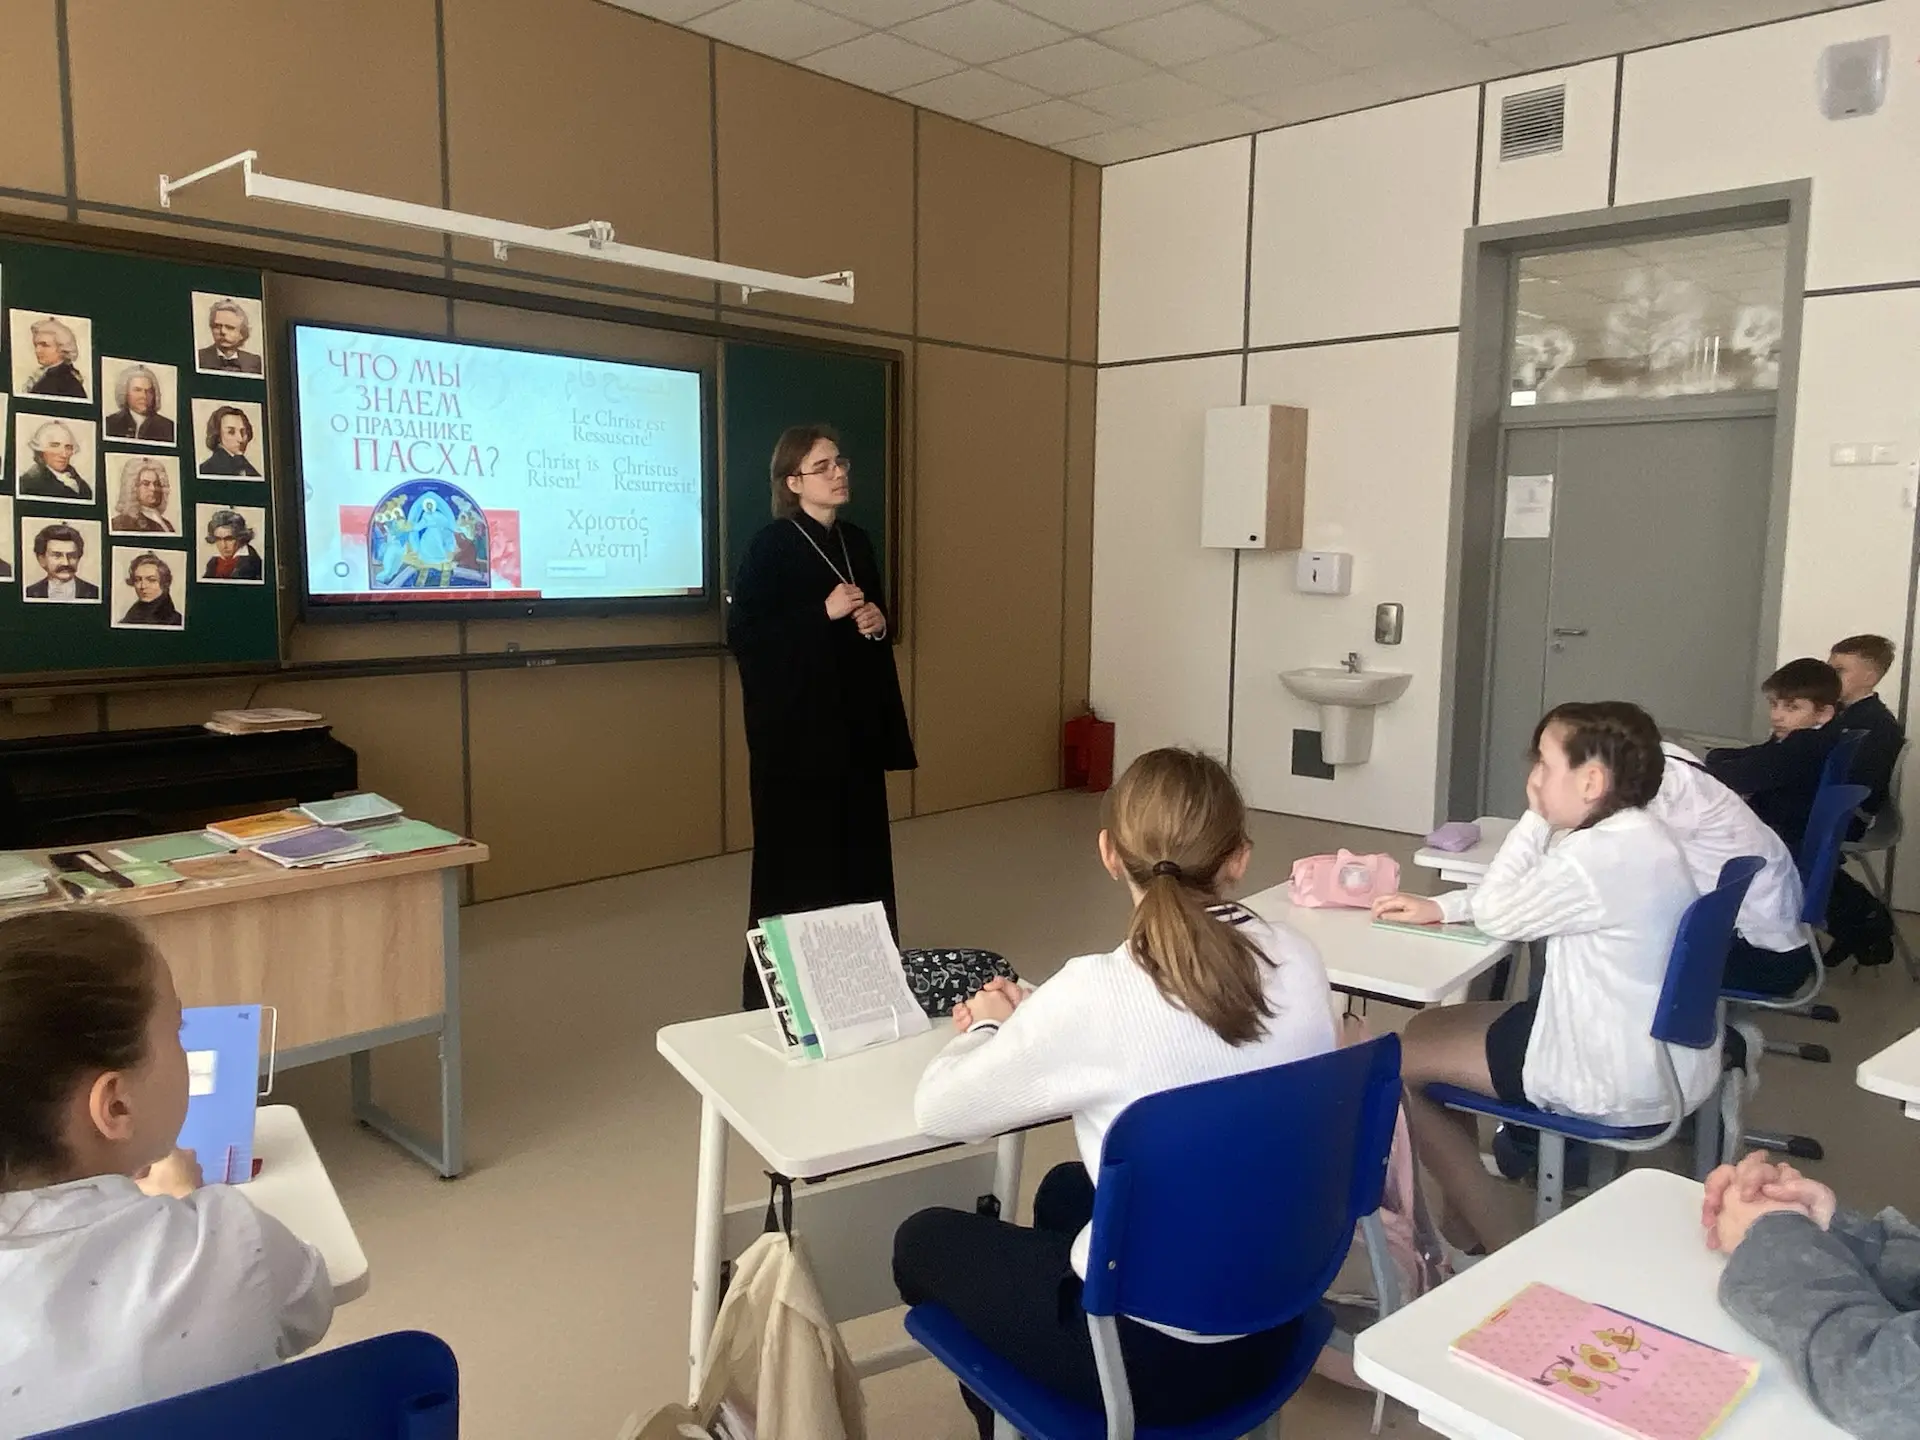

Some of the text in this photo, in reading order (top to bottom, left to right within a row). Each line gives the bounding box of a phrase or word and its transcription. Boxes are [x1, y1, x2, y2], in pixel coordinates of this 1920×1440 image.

[328, 350, 461, 388] ЧТО МЫ
[355, 385, 463, 419] ЗНАЕМ
[330, 414, 473, 442] О ПРАЗДНИКЕ
[573, 407, 591, 426] Le
[595, 409, 643, 430] Christ
[353, 437, 499, 477] ПАСХА?
[526, 448, 600, 472] Christ is
[612, 455, 679, 478] Christus
[527, 468, 582, 489] Risen!
[613, 473, 697, 494] Resurrexit!
[565, 508, 650, 537] Χριστός
[567, 535, 649, 565] Ανέστη!
